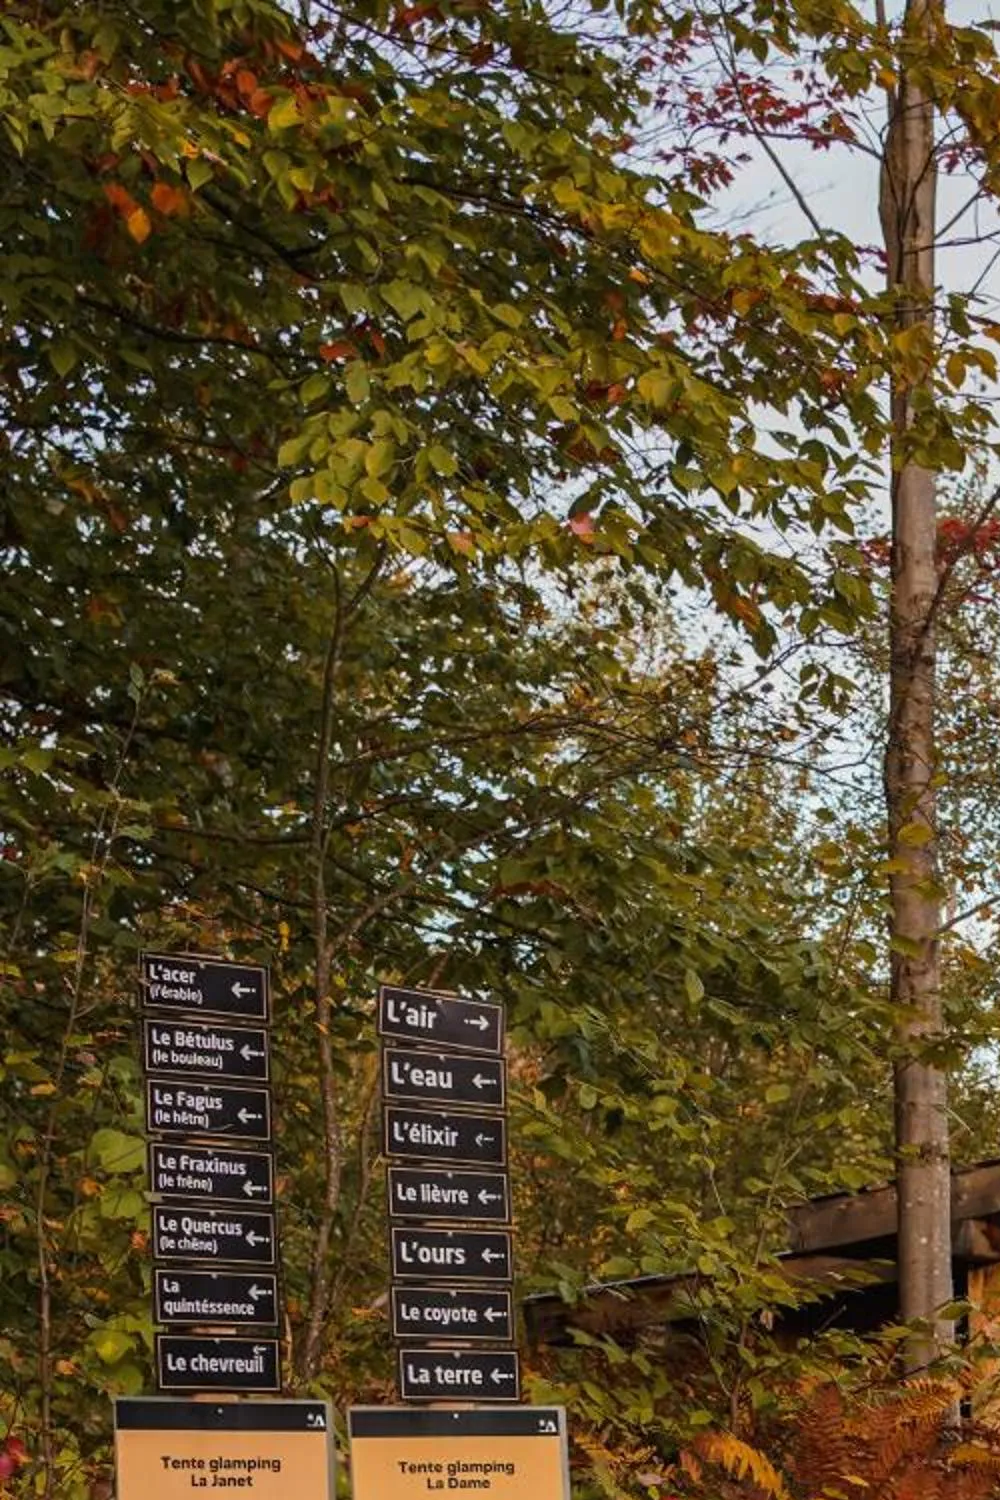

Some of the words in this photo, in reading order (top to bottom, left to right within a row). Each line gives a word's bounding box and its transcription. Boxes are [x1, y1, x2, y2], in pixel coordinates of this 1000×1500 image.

[149, 964, 196, 984] L'acer
[387, 999, 437, 1029] L'air
[152, 1028, 171, 1045] Le
[175, 1031, 234, 1051] Bétulus
[152, 1049, 168, 1065] (le
[171, 1050, 223, 1070] bouleau)
[391, 1061, 453, 1089] L'eau
[154, 1089, 173, 1105] Le
[176, 1091, 223, 1112] Fagus
[154, 1109, 171, 1125] (le
[173, 1110, 209, 1129] hêtre)
[393, 1121, 459, 1147] L'élixir
[158, 1153, 177, 1170] Le
[180, 1155, 247, 1175] Fraxinus
[158, 1173, 175, 1189] (le
[397, 1183, 417, 1201] Le
[420, 1183, 469, 1204] lièvre
[159, 1215, 177, 1231] Le
[181, 1216, 243, 1236] Quercus
[159, 1235, 175, 1251] (le
[178, 1236, 218, 1254] chêne)
[401, 1241, 466, 1265] L'ours
[163, 1278, 180, 1293] La
[163, 1298, 255, 1316] quintéssence
[401, 1303, 420, 1321] Le
[423, 1306, 478, 1326] coyote
[167, 1353, 187, 1371] Le
[190, 1353, 265, 1373] chevreuil
[407, 1363, 430, 1384] La
[434, 1365, 483, 1385] terre
[160, 1456, 205, 1470] Tente
[209, 1457, 282, 1473] glamping
[398, 1460, 443, 1473] Tente
[447, 1460, 515, 1476] glamping
[191, 1474, 207, 1487] La
[211, 1475, 253, 1488] Janet
[426, 1477, 444, 1490] La
[448, 1477, 490, 1489] Dame
